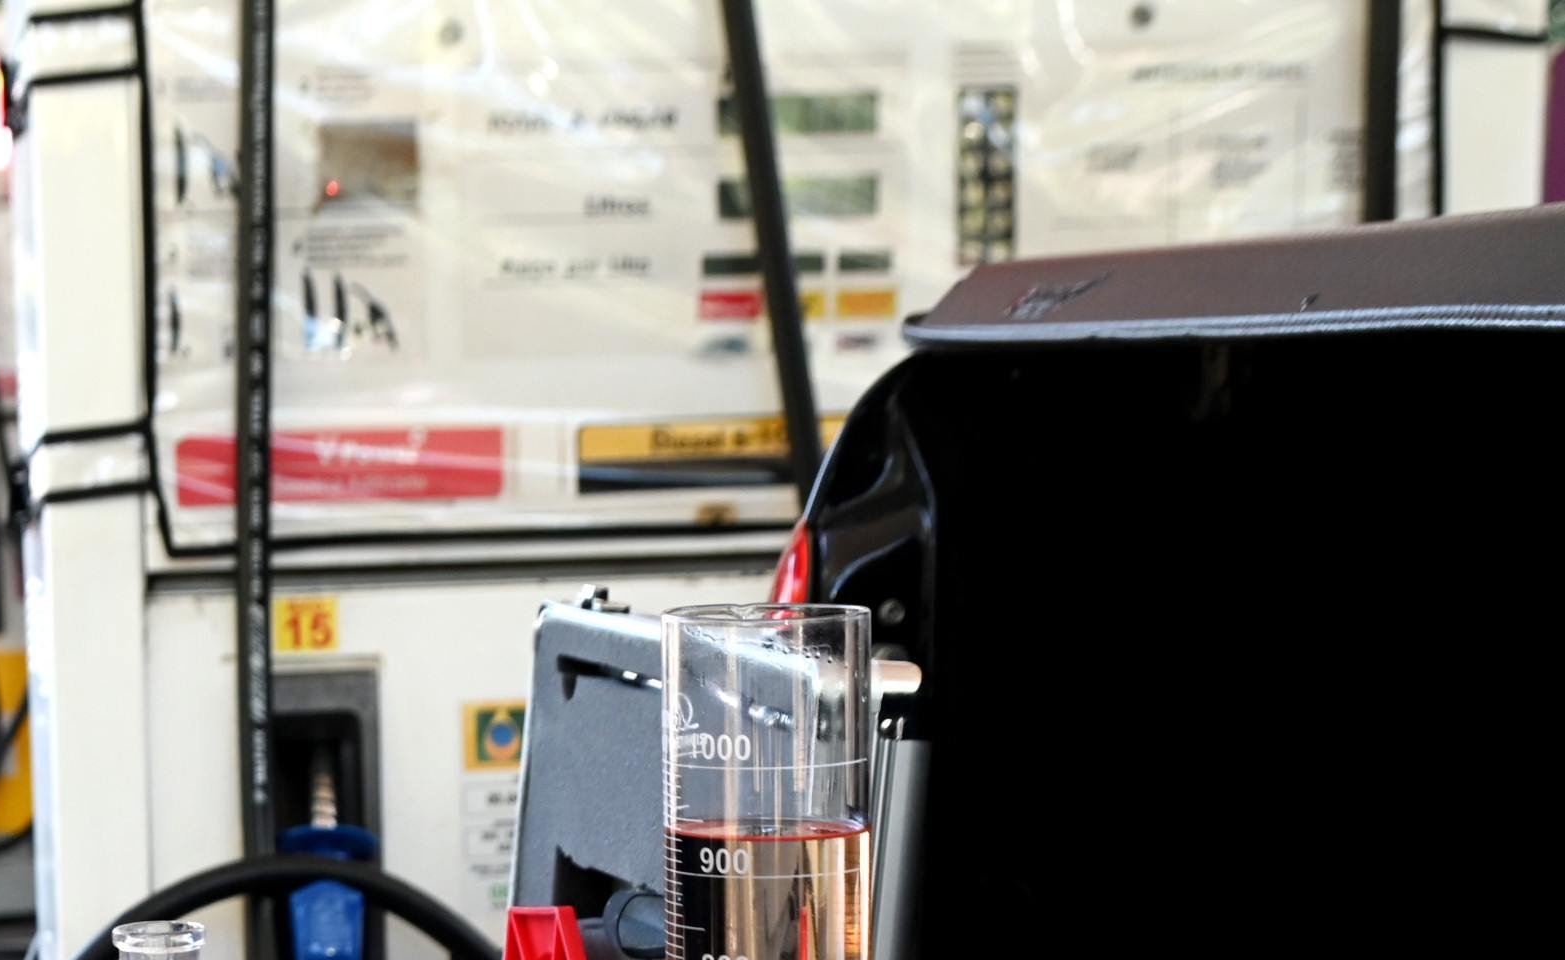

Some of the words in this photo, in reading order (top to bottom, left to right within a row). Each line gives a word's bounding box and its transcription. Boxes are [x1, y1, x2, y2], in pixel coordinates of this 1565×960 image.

[283, 611, 334, 650] 15
[691, 732, 751, 761] 1000
[699, 846, 751, 875] 900
